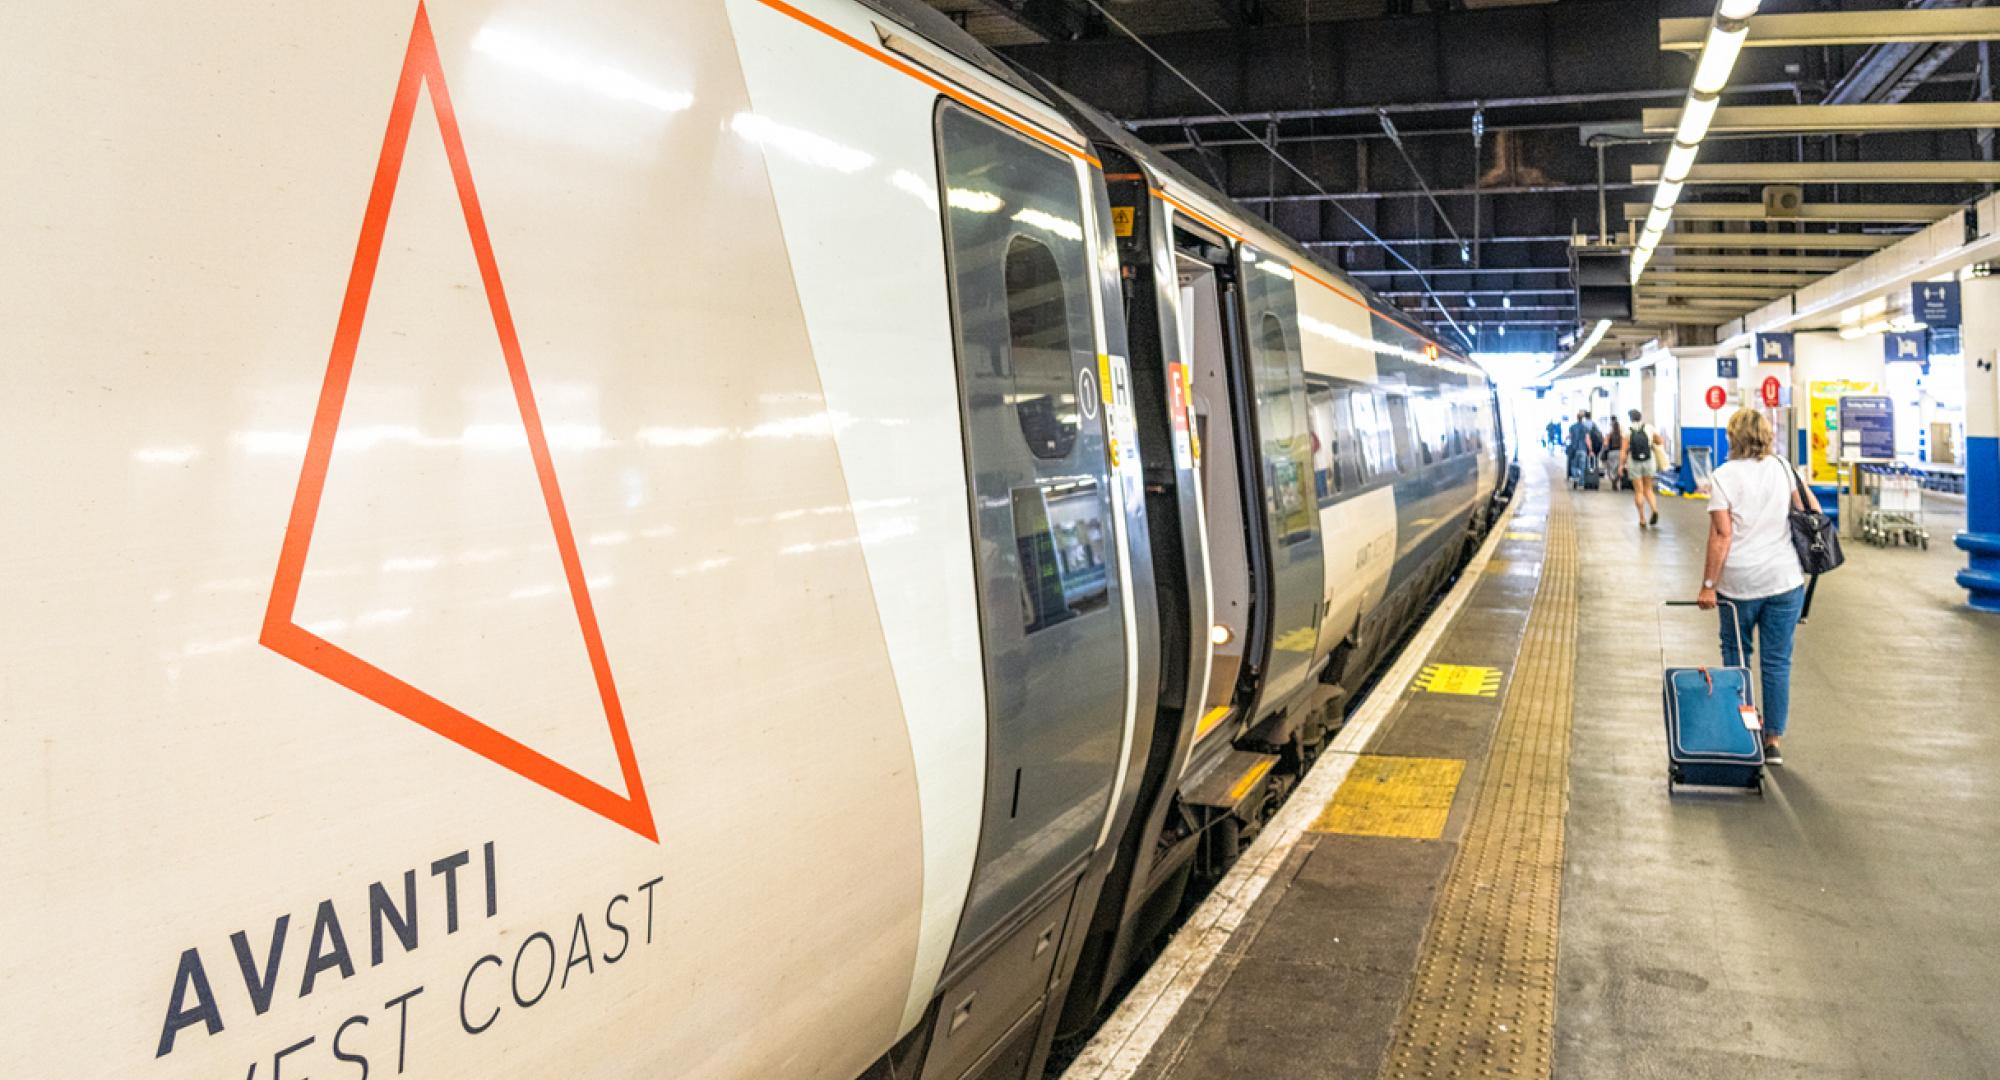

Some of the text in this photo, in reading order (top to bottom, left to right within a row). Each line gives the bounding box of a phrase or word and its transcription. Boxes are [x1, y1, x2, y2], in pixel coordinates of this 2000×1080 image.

[1114, 367, 1127, 406] H
[1172, 370, 1181, 407] F
[1711, 390, 1720, 403] E
[1765, 383, 1776, 400] U
[155, 840, 498, 1059] AVANTI
[246, 875, 664, 1080] ST COAST
